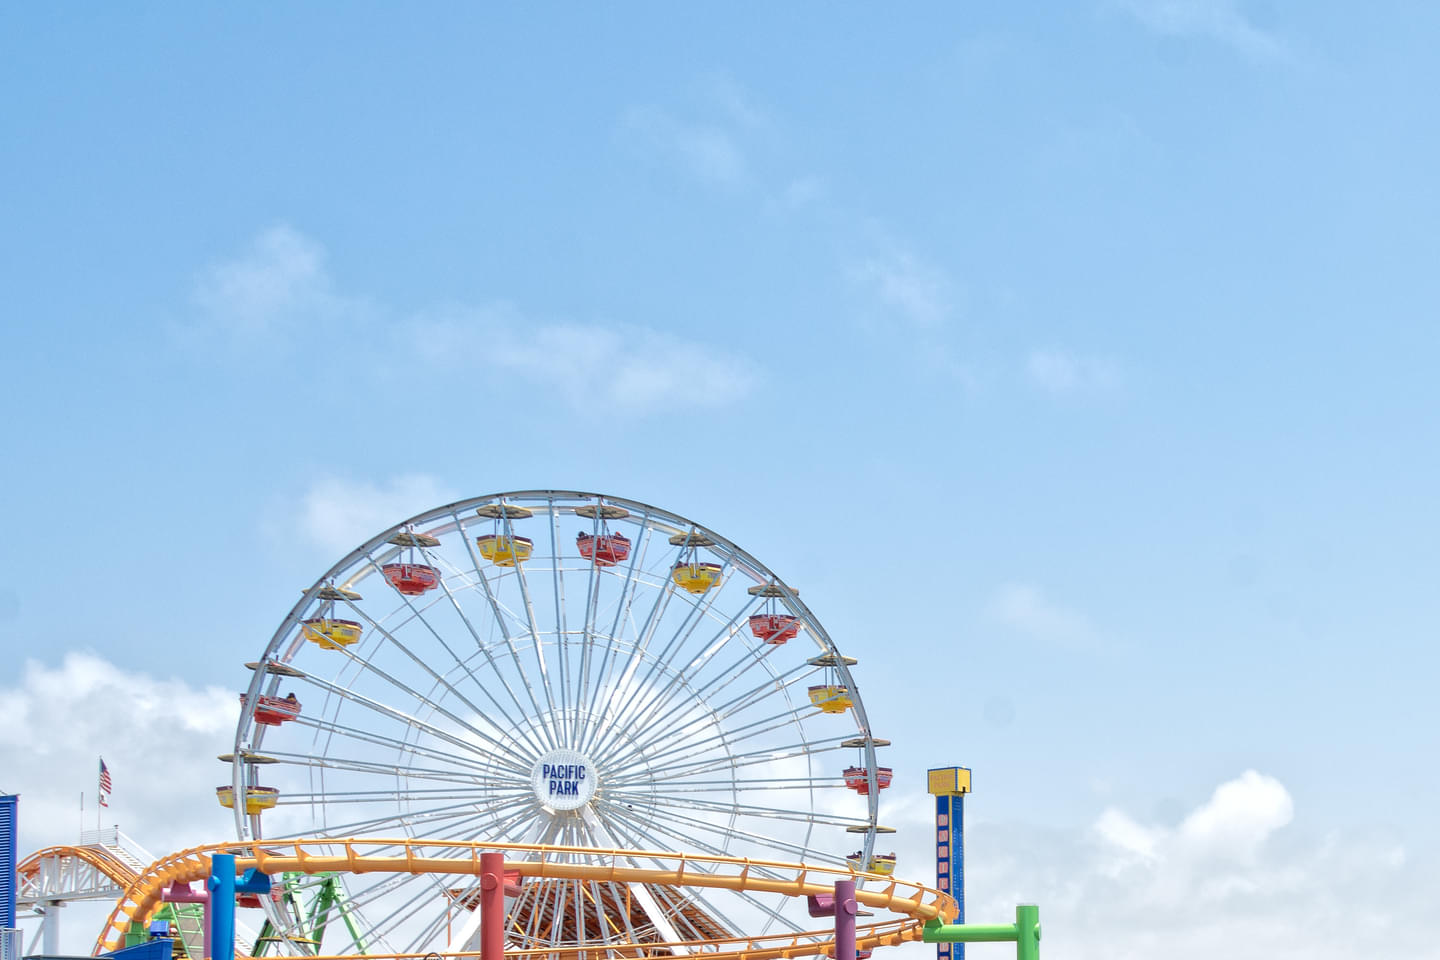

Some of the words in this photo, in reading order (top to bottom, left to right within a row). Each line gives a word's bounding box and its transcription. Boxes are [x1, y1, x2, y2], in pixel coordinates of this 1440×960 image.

[543, 764, 586, 780] PACIFIC
[549, 781, 579, 796] PARK
[938, 814, 949, 890] PACIF
